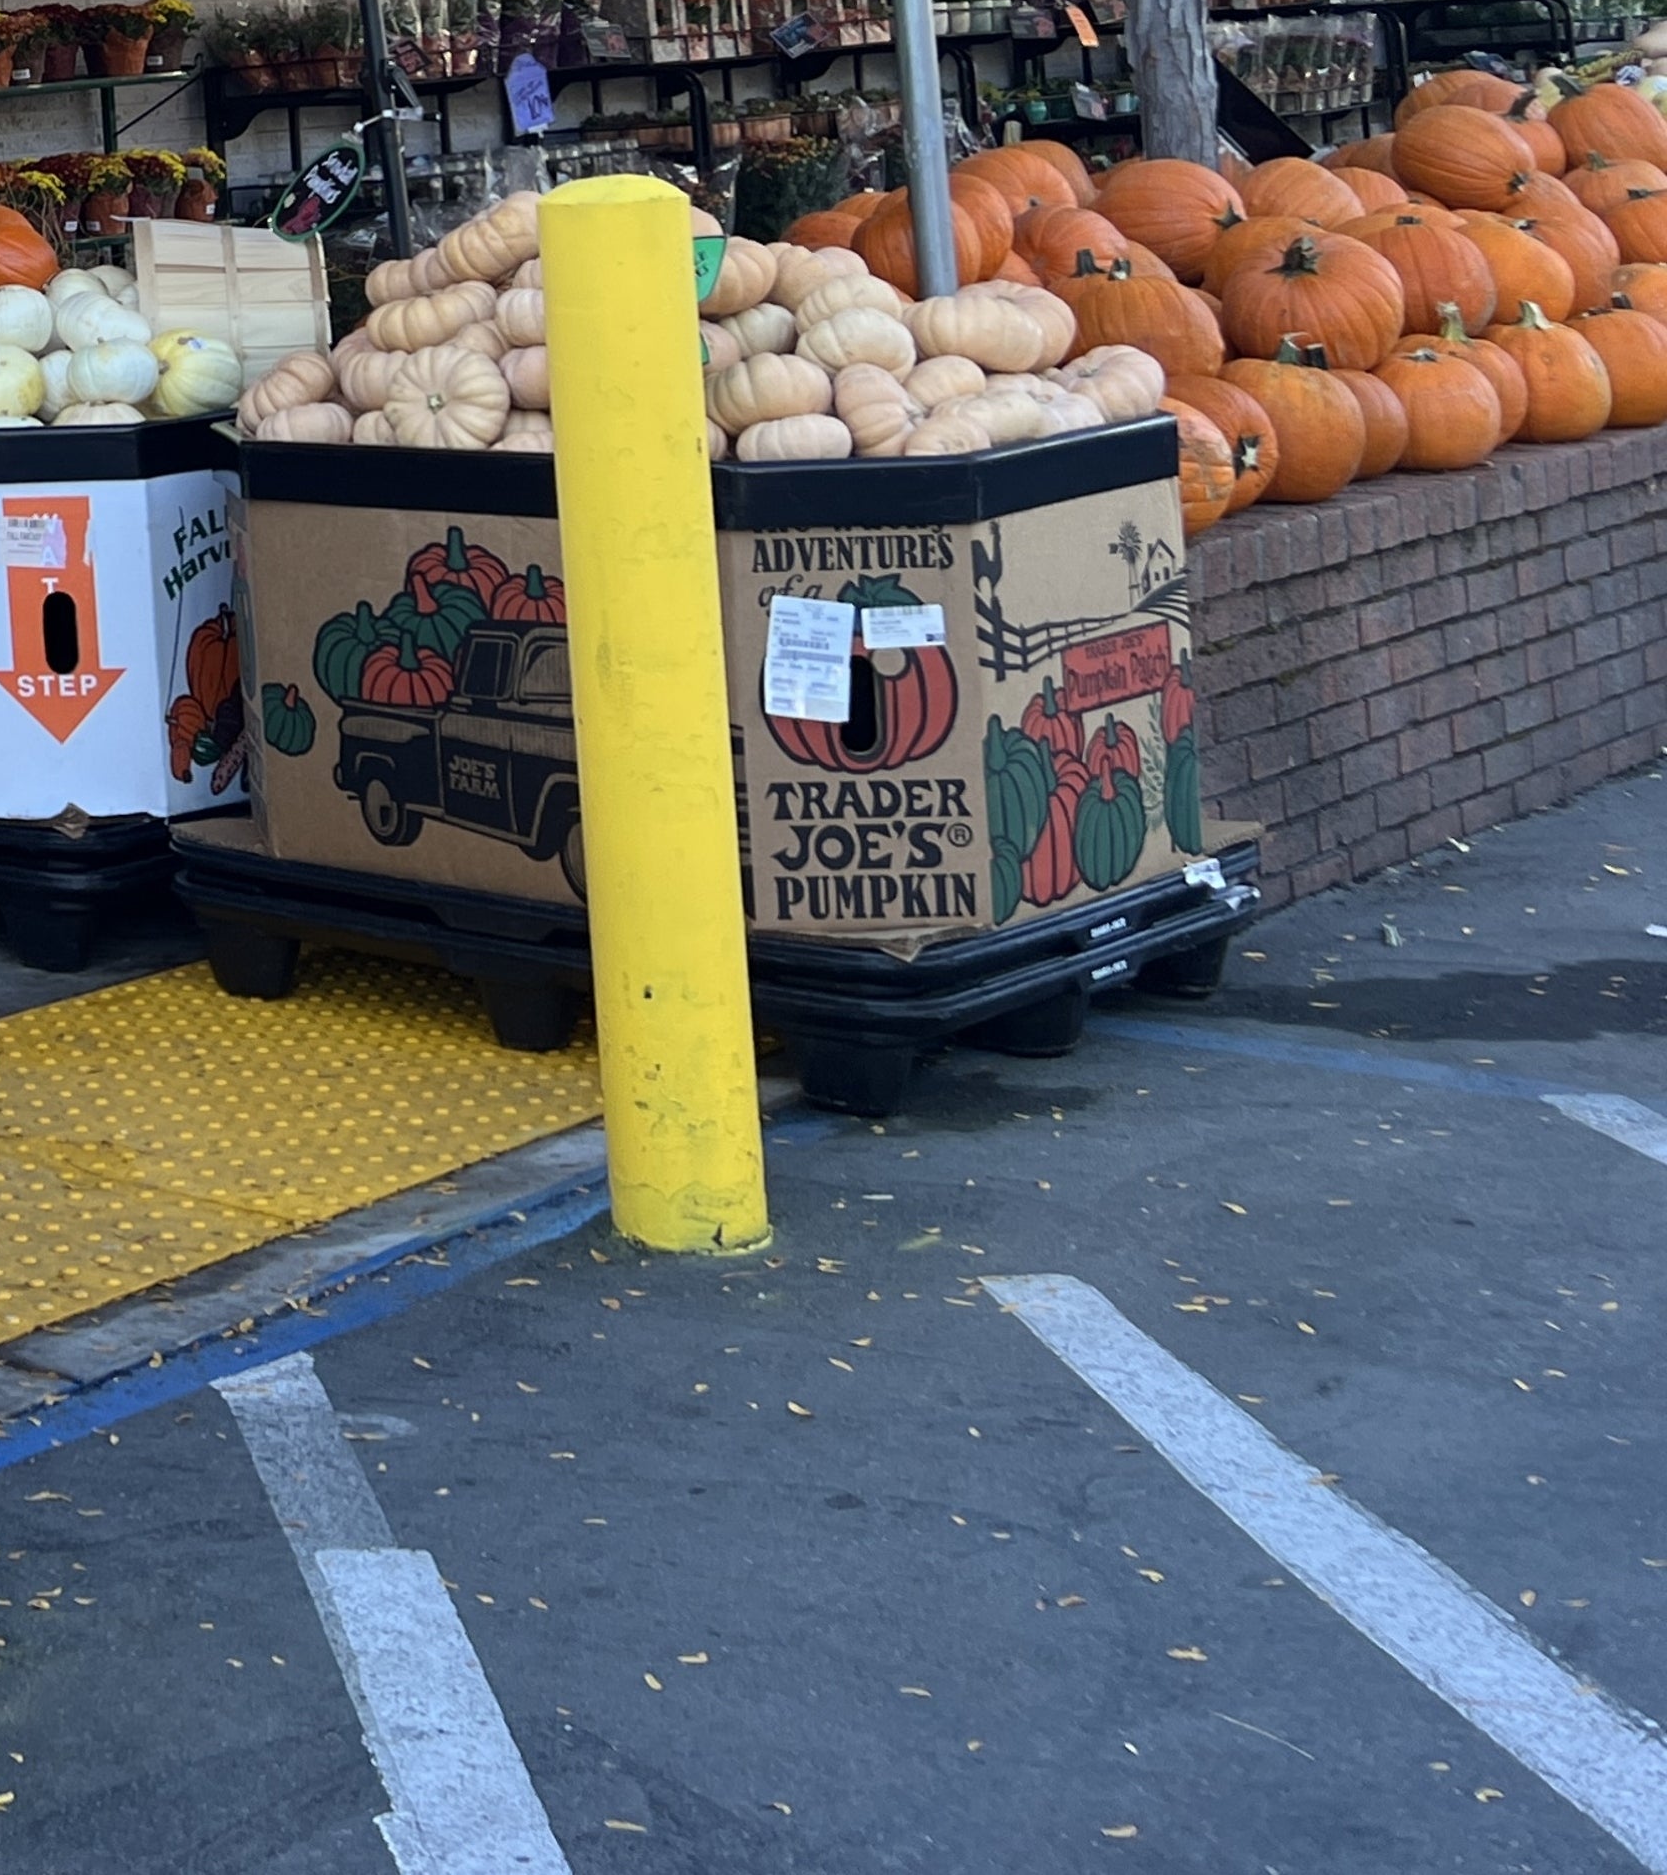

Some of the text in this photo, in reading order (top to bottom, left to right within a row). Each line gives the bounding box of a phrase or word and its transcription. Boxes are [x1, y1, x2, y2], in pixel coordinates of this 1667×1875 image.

[751, 533, 955, 574] ADVENTURES
[17, 674, 98, 698] STEP
[1066, 644, 1167, 703] Pumpkin Patch
[448, 754, 497, 781] JOE'S
[449, 772, 502, 800] FARM
[765, 778, 973, 821] TRADER
[773, 872, 977, 921] PUMPKIN
